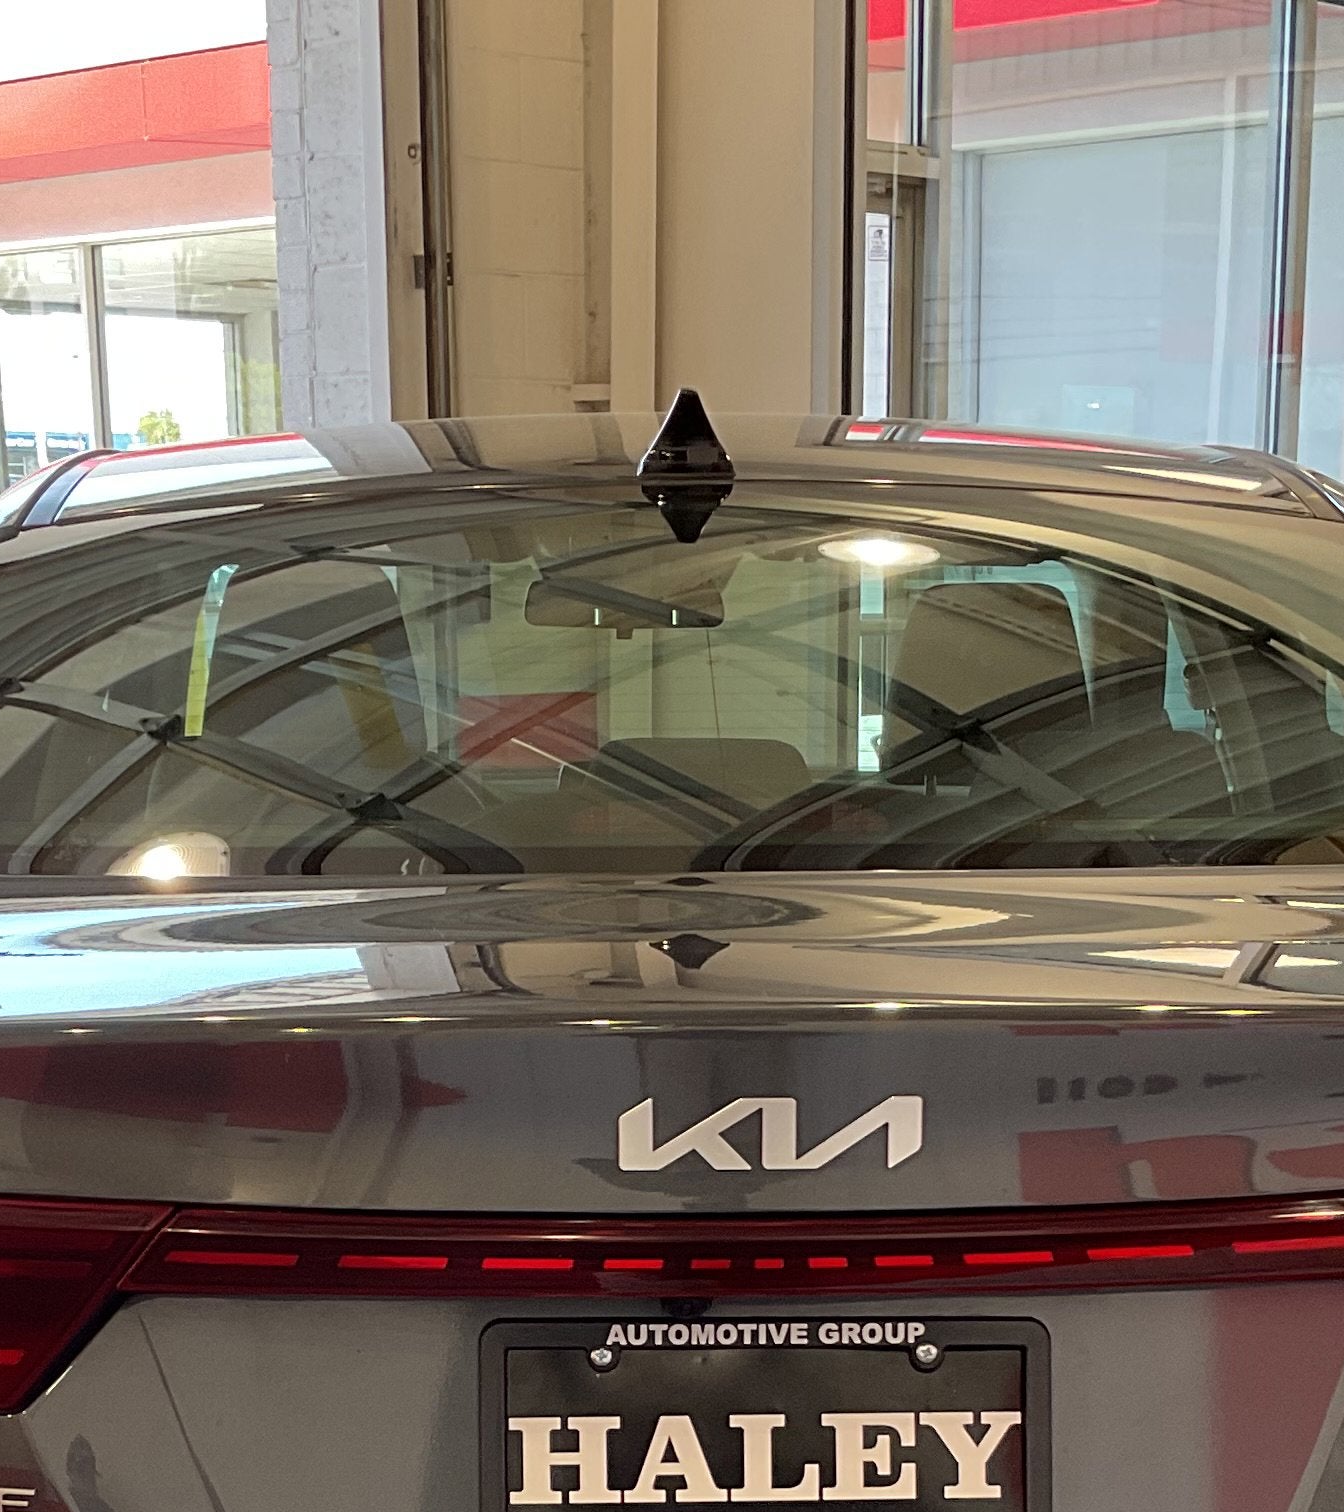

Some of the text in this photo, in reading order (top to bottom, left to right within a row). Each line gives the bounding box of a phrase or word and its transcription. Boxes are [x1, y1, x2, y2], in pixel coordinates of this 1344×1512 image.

[618, 1095, 924, 1171] KIA
[606, 1322, 926, 1347] AUTOMOTIVE GROUP
[508, 1411, 1022, 1505] HALEY
